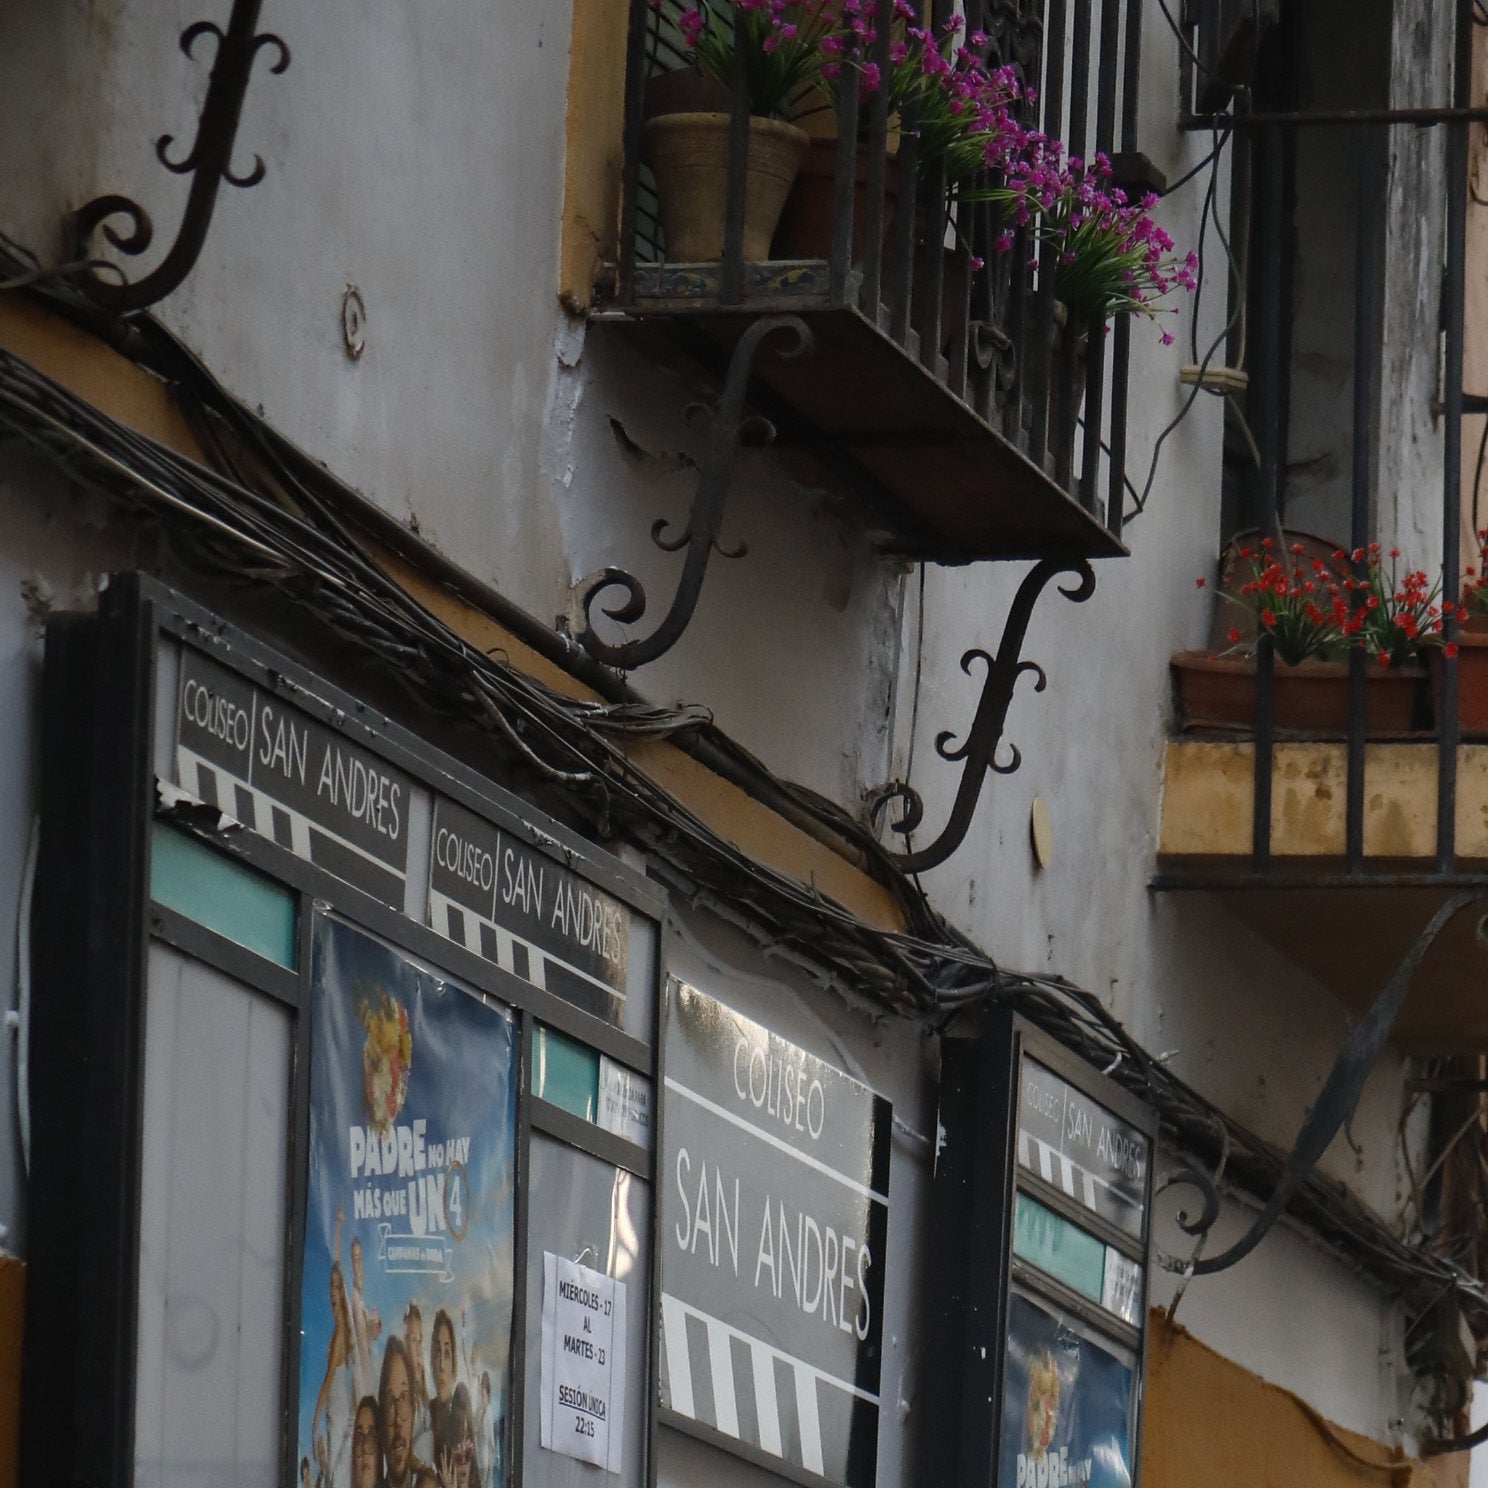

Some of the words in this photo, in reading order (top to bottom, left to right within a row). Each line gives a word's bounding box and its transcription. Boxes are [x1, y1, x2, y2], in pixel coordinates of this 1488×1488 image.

[184, 680, 249, 750] COLISEO
[260, 706, 308, 786] SAN
[318, 744, 401, 840] ANDRES
[436, 828, 493, 891] COLISEO
[502, 848, 544, 921] SAN
[551, 880, 622, 964] ANDRES
[733, 1038, 825, 1140] COLISEO
[350, 1119, 427, 1179] PADRE
[428, 1144, 444, 1168] NO
[445, 1137, 471, 1166] HAY
[1067, 1102, 1093, 1148] SAN
[1096, 1126, 1141, 1179] ANDRES
[353, 1182, 382, 1220] MÁS
[383, 1189, 408, 1217] QUE
[675, 1148, 740, 1278] SAN
[754, 1194, 872, 1341] ANDRES
[559, 1279, 599, 1311] MIÉRCOLES
[604, 1300, 612, 1316] 17
[564, 1334, 594, 1360] MARTES
[583, 1315, 592, 1334] AL
[559, 1384, 588, 1409] SESIÓN
[575, 1416, 595, 1438] 22:15
